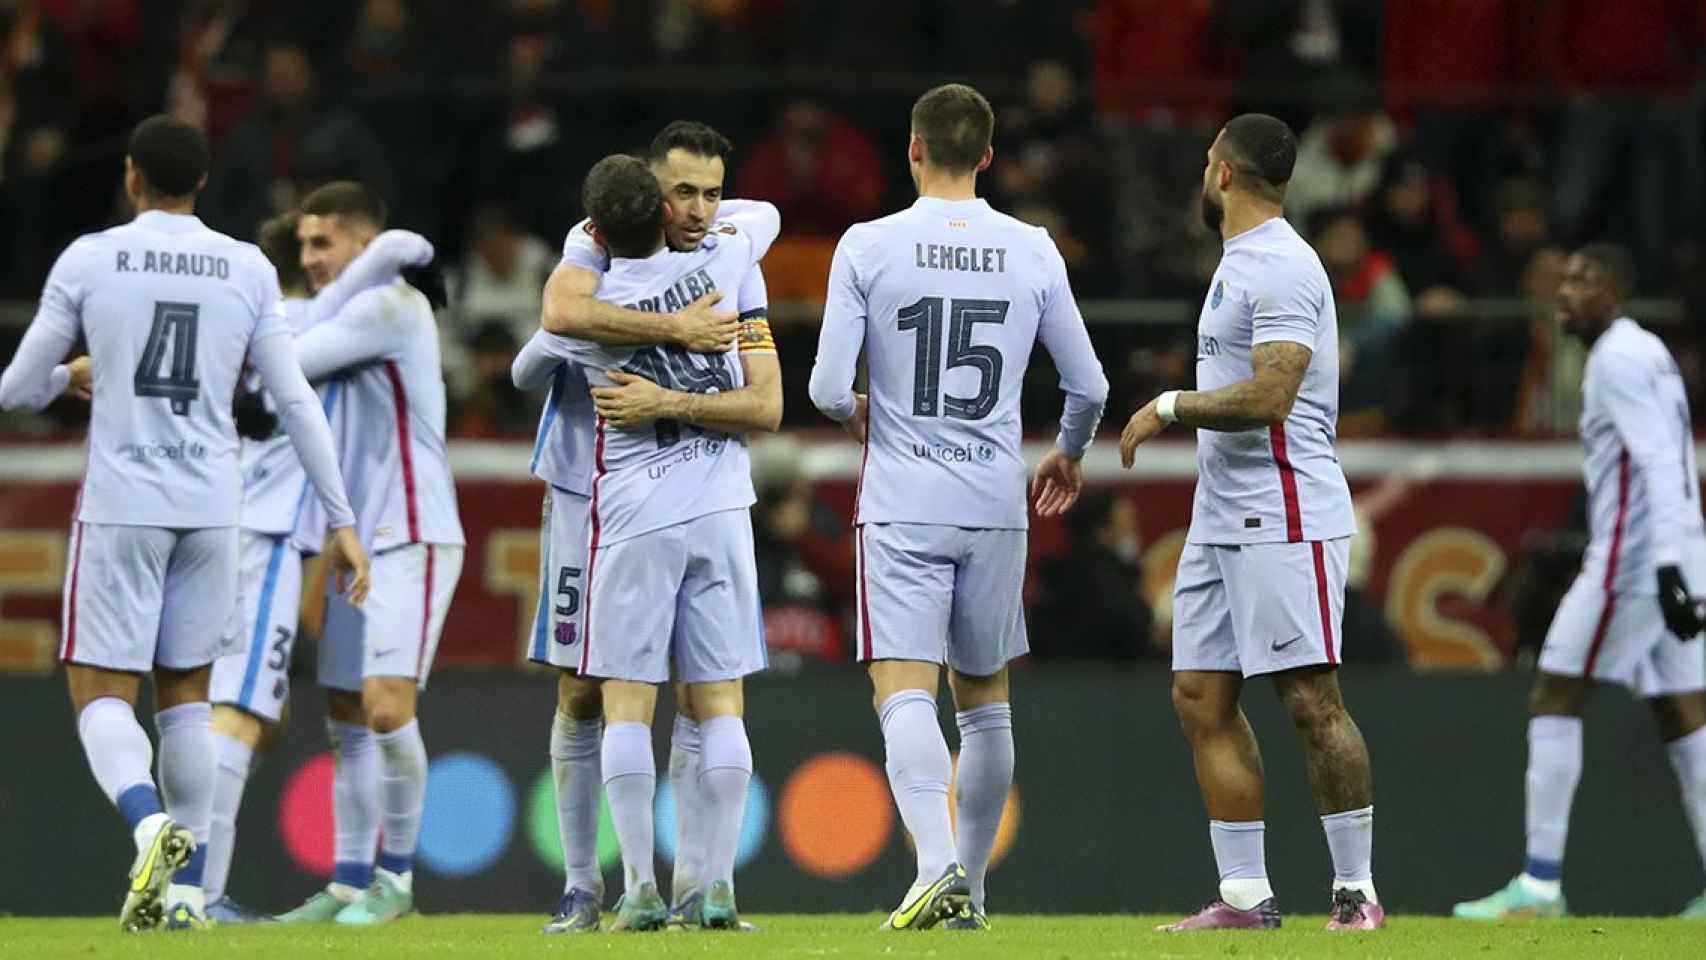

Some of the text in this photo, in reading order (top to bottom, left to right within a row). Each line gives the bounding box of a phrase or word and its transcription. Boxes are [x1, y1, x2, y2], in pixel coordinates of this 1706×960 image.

[116, 250, 229, 280] R. ARAUJO
[916, 243, 1006, 272] LENGLET
[133, 300, 200, 417] 4
[898, 296, 1010, 421] 15
[913, 444, 972, 462] unicef
[556, 566, 581, 616] 5
[268, 625, 290, 671] 3
